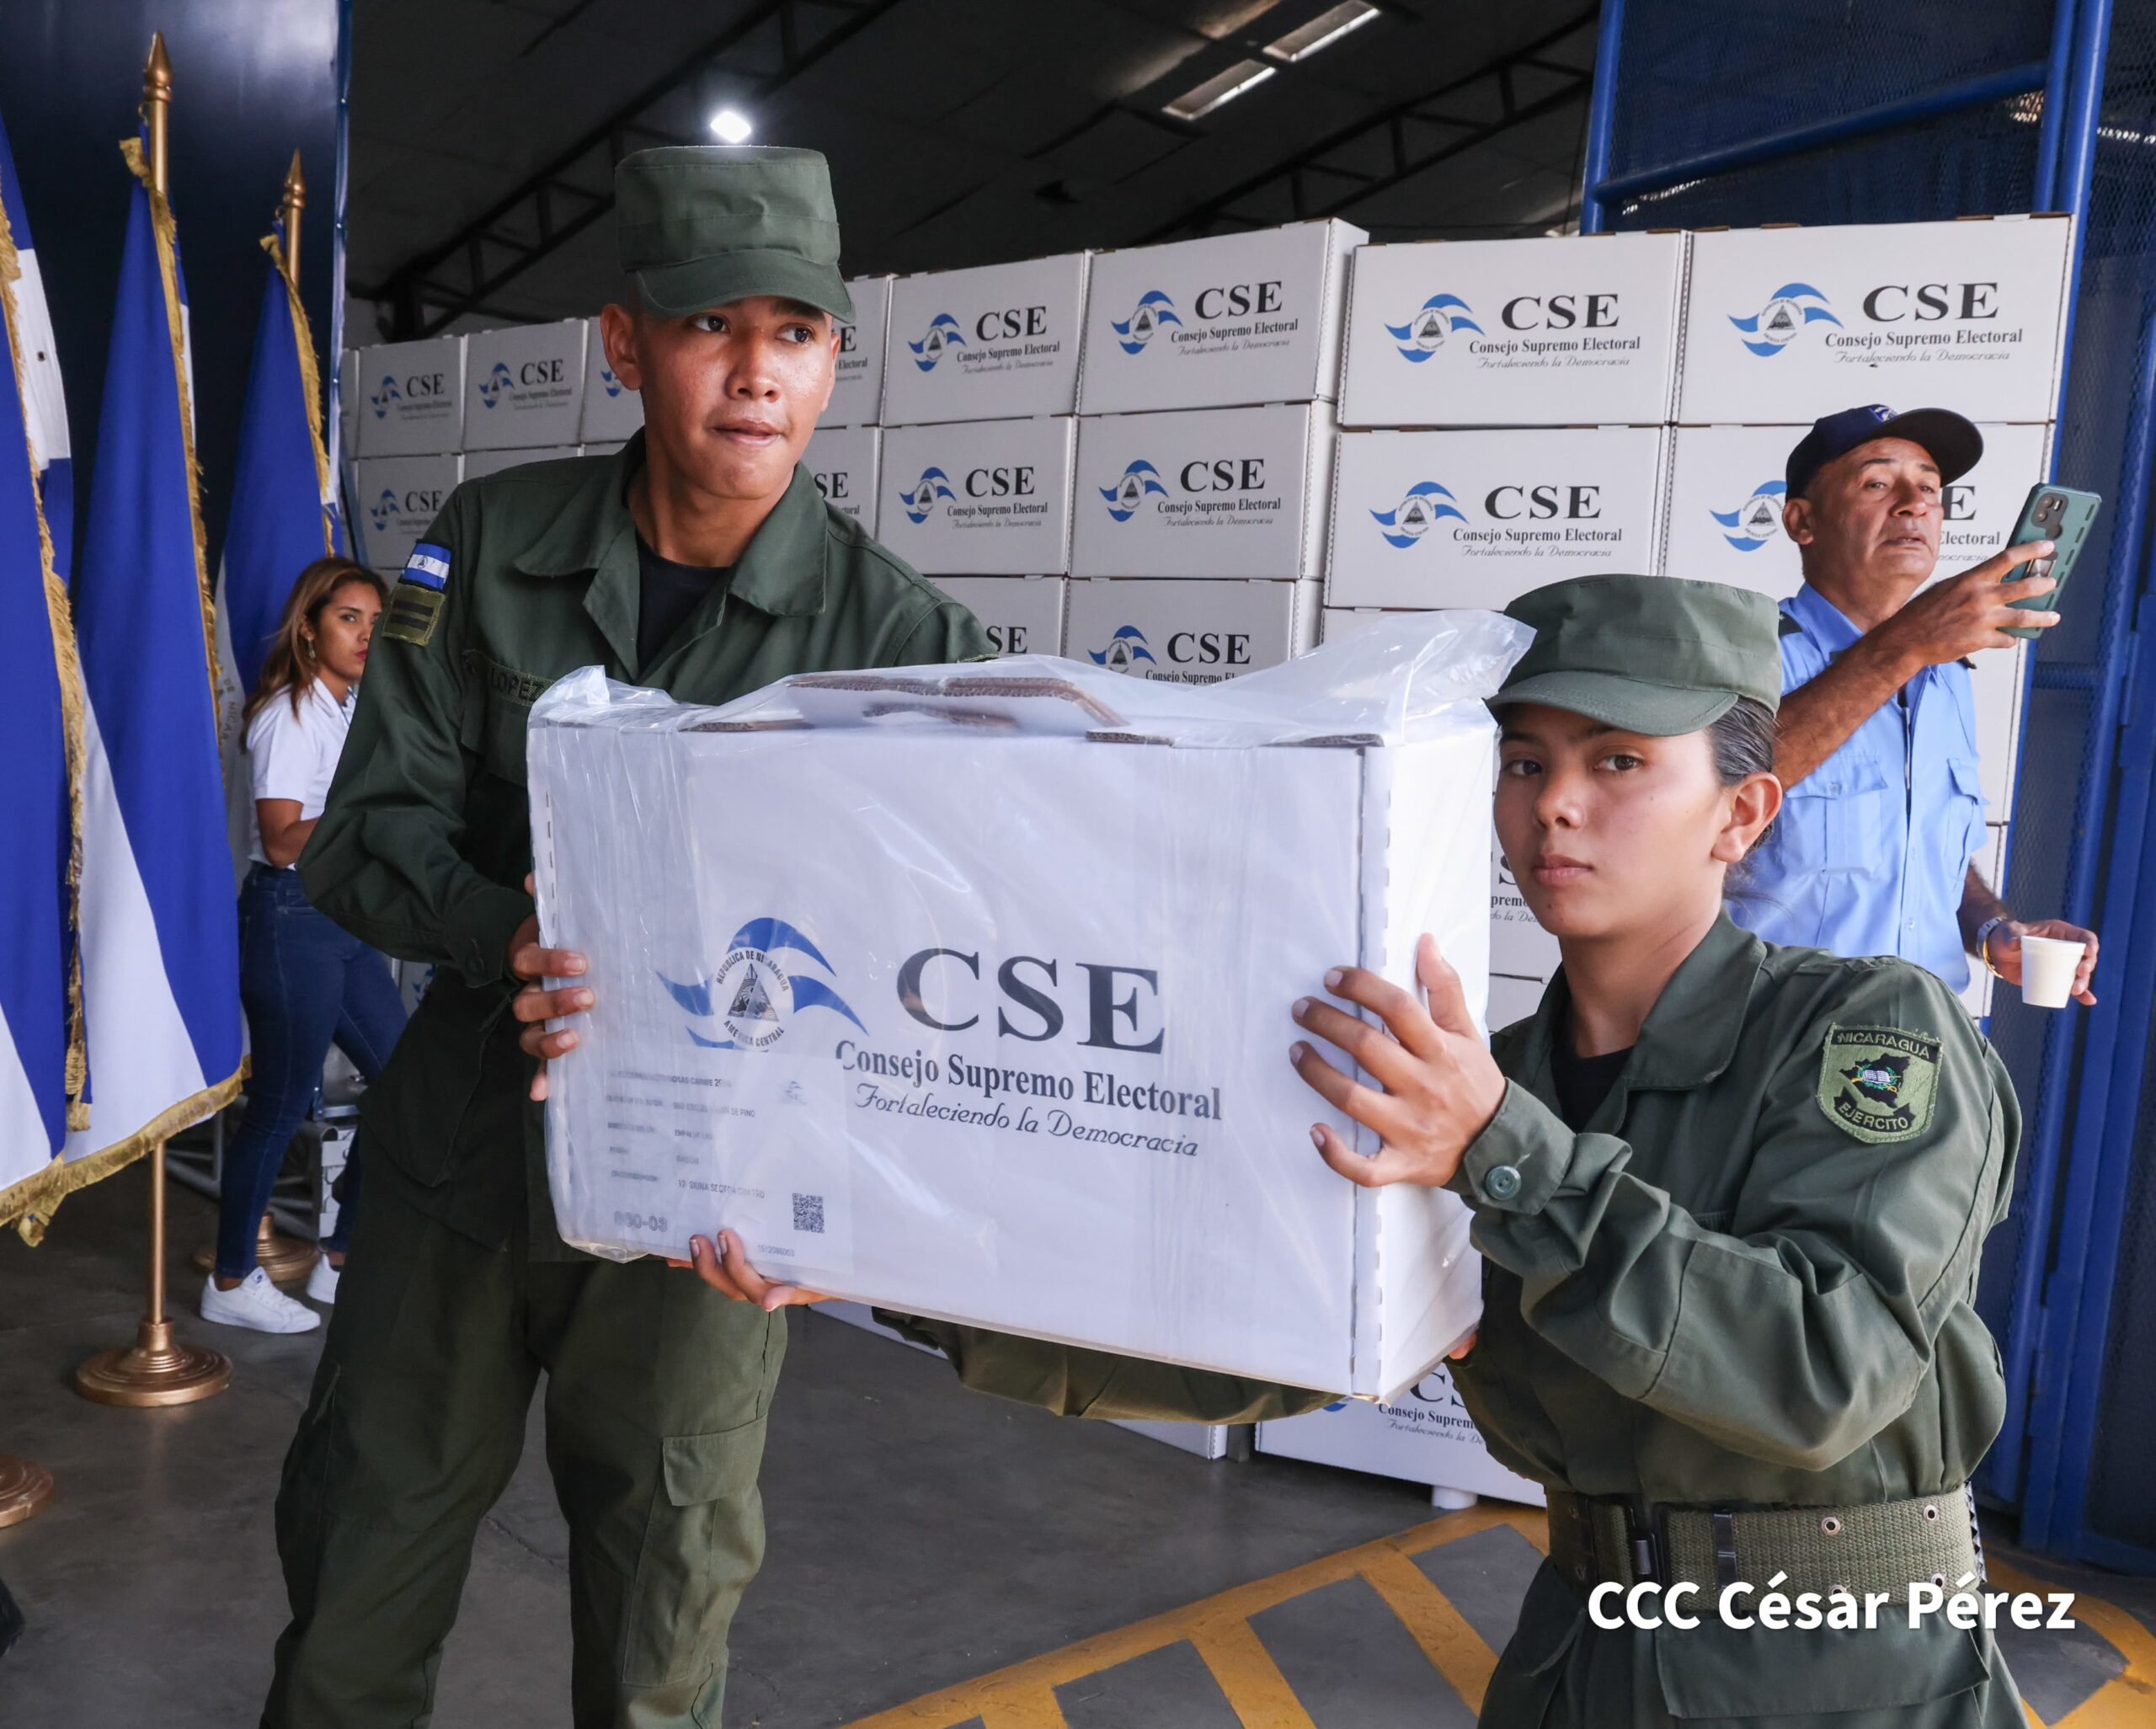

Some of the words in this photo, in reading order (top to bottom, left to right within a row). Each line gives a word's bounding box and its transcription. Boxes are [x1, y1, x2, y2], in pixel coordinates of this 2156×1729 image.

[1194, 280, 1283, 320] CSE
[1502, 293, 1620, 330] CSE
[1863, 282, 1999, 322] CSE
[975, 306, 1047, 341] CSE
[1171, 330, 1207, 344] Consejo
[1209, 324, 1251, 342] Supremo
[1254, 318, 1298, 334] Electoral
[957, 351, 986, 364] Consejo
[989, 346, 1022, 360] Supremo
[1024, 341, 1059, 355] Electoral
[1469, 340, 1518, 356] Consejo
[1522, 339, 1578, 355] Supremo
[1582, 336, 1641, 351] Electoral
[1826, 333, 1881, 350] Consejo
[1886, 331, 1951, 348] Supremo
[1956, 328, 2023, 344] Electoral
[1477, 357, 1549, 370] Fortaleciendo
[1551, 355, 1561, 366] la
[1566, 354, 1630, 366] Democracia
[1834, 351, 1917, 365] Fortaleciendo
[1920, 350, 1931, 362] la
[1937, 348, 2010, 361] Democracia
[406, 373, 445, 398] CSE
[520, 359, 564, 386] CSE
[814, 472, 849, 499] SE
[965, 467, 1035, 498] CSE
[1180, 458, 1266, 492] CSE
[947, 505, 975, 518] Consejo
[978, 504, 1011, 517] Supremo
[1013, 502, 1048, 515] Electoral
[1157, 501, 1193, 515] Consejo
[1194, 499, 1235, 515] Supremo
[1238, 497, 1281, 510] Electoral
[1484, 485, 1601, 520] CSE
[1453, 528, 1501, 544] Consejo
[1505, 528, 1561, 544] Supremo
[1565, 528, 1622, 542] Electoral
[1460, 545, 1532, 557] Fortaleciendo
[1534, 545, 1544, 557] la
[1548, 546, 1611, 557] Democracia
[985, 626, 1027, 654] SE
[1167, 632, 1251, 664] CSE
[716, 951, 745, 985] REPUBLICA
[744, 950, 755, 960] DE
[896, 947, 1166, 1055] CSE
[755, 1026, 785, 1047] CENTRAL
[1837, 1032, 1930, 1059] NICARAGUA
[835, 1039, 940, 1087] Consejo
[947, 1054, 1075, 1099] Supremo
[1083, 1070, 1222, 1120] Electoral
[855, 1082, 1010, 1129] Fortaleciendo
[1016, 1106, 1039, 1133] la
[1047, 1109, 1199, 1157] Democracia
[1838, 1102, 1909, 1130] EJERCITO
[1379, 1403, 1424, 1422] Consejo
[1428, 1410, 1474, 1430] Suprem
